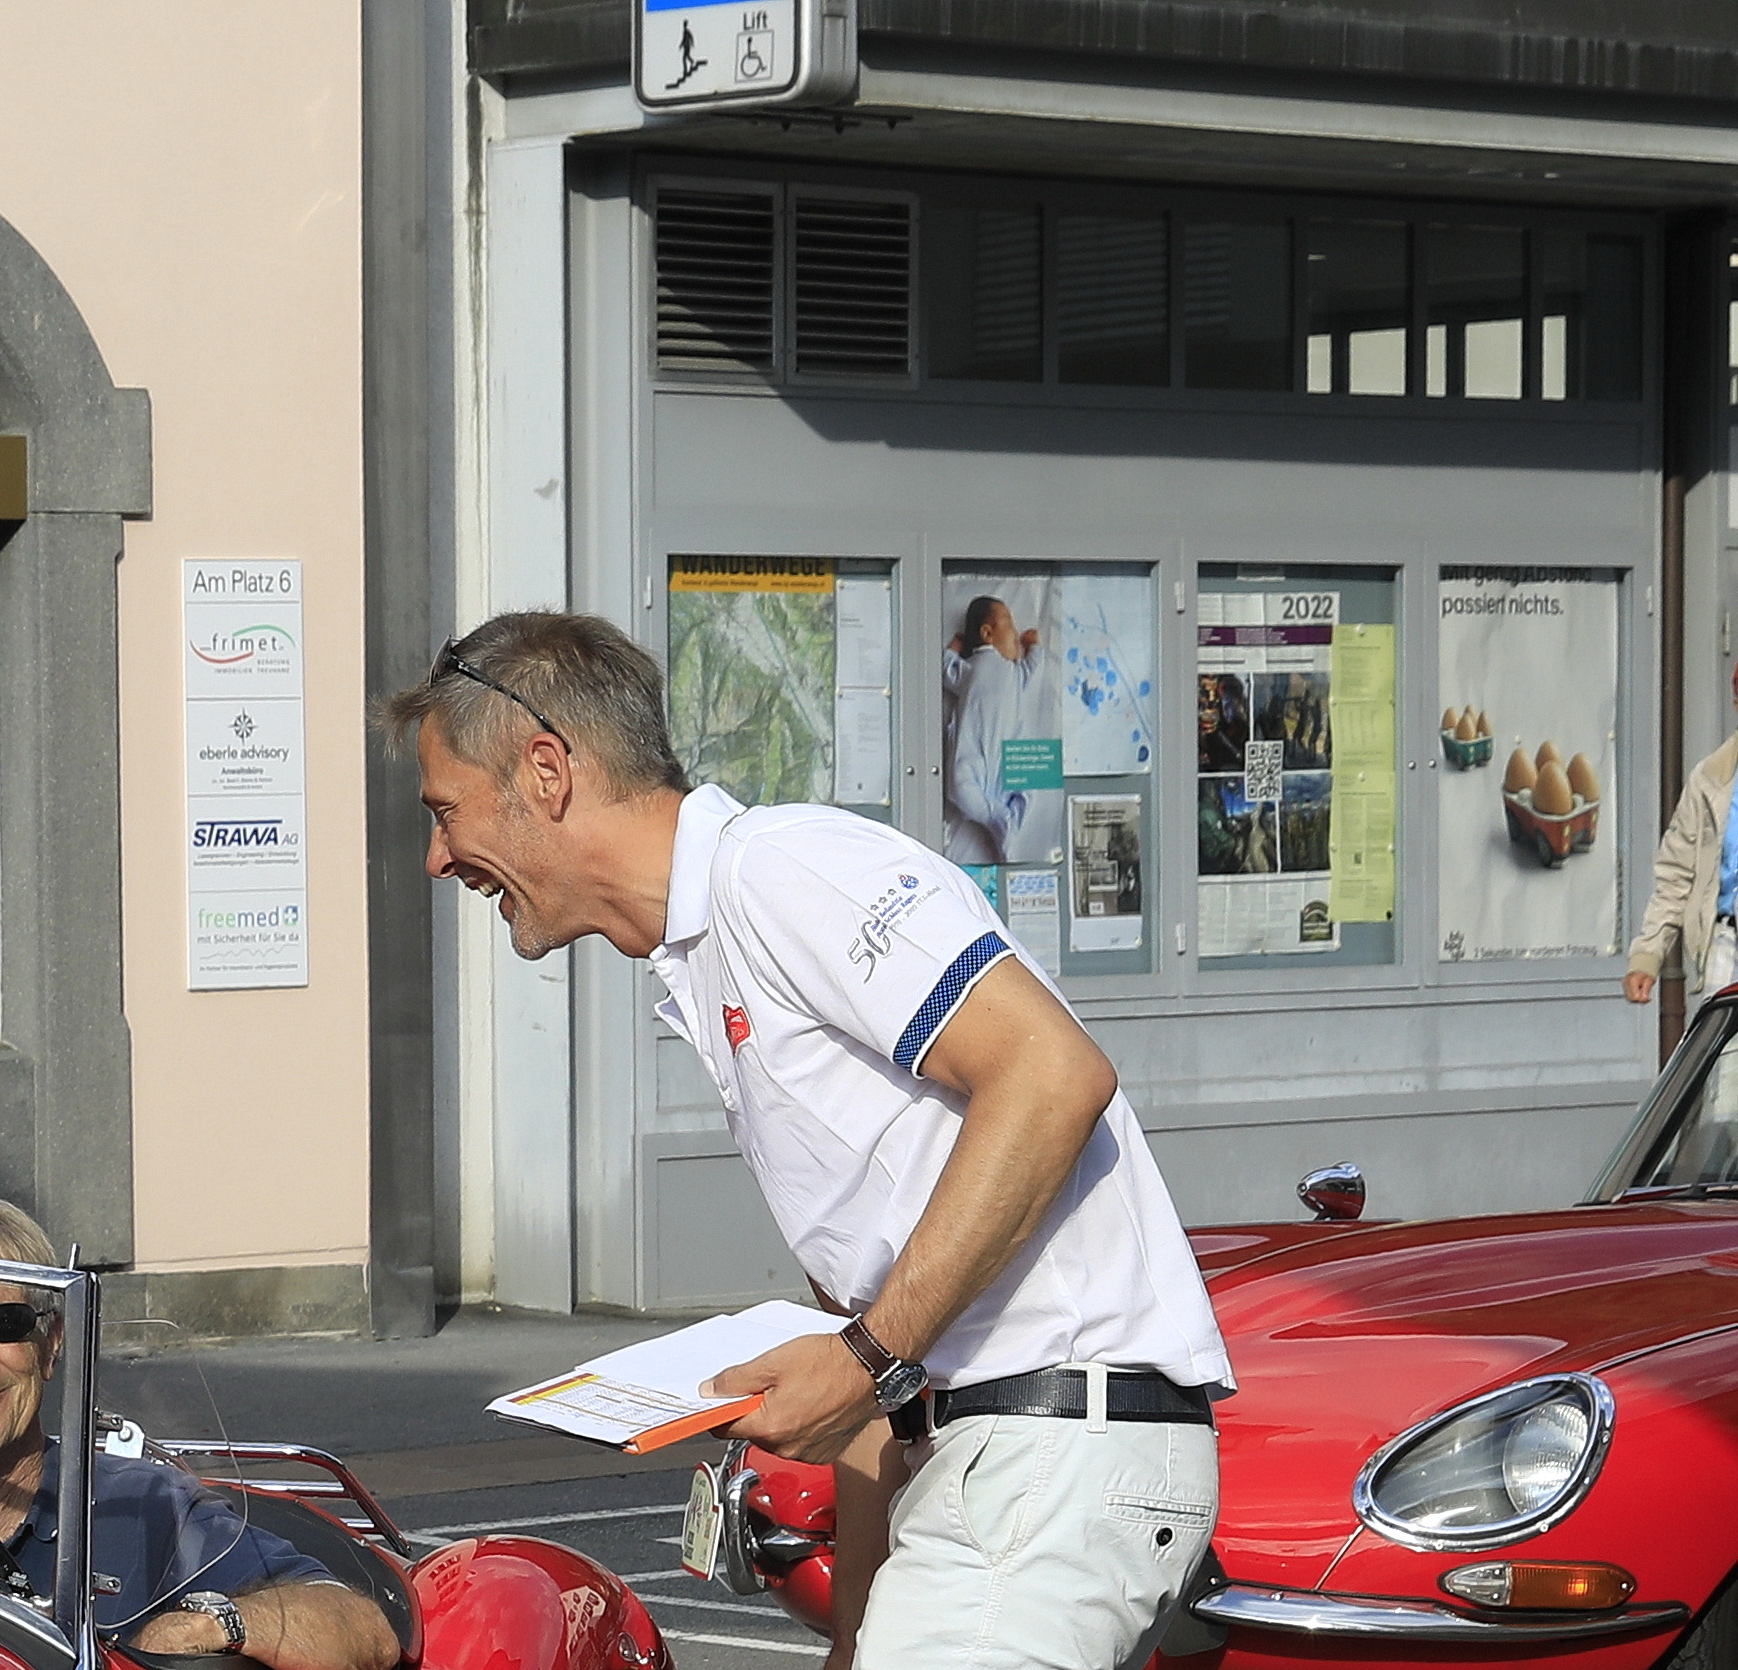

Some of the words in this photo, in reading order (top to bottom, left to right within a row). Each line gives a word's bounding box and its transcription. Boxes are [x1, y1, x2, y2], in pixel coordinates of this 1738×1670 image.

[743, 12, 768, 30] Lift
[193, 570, 225, 592] Am
[232, 570, 274, 592] Platz
[279, 570, 291, 592] 6
[1281, 595, 1334, 620] 2022
[1442, 593, 1505, 618] passiert
[1508, 593, 1564, 615] nichts.
[199, 745, 238, 760] eberle
[240, 744, 289, 763] advisory
[193, 819, 283, 847] STRAWA
[282, 833, 299, 845] AG
[199, 906, 280, 928] freemed
[214, 933, 256, 944] Sicherheit
